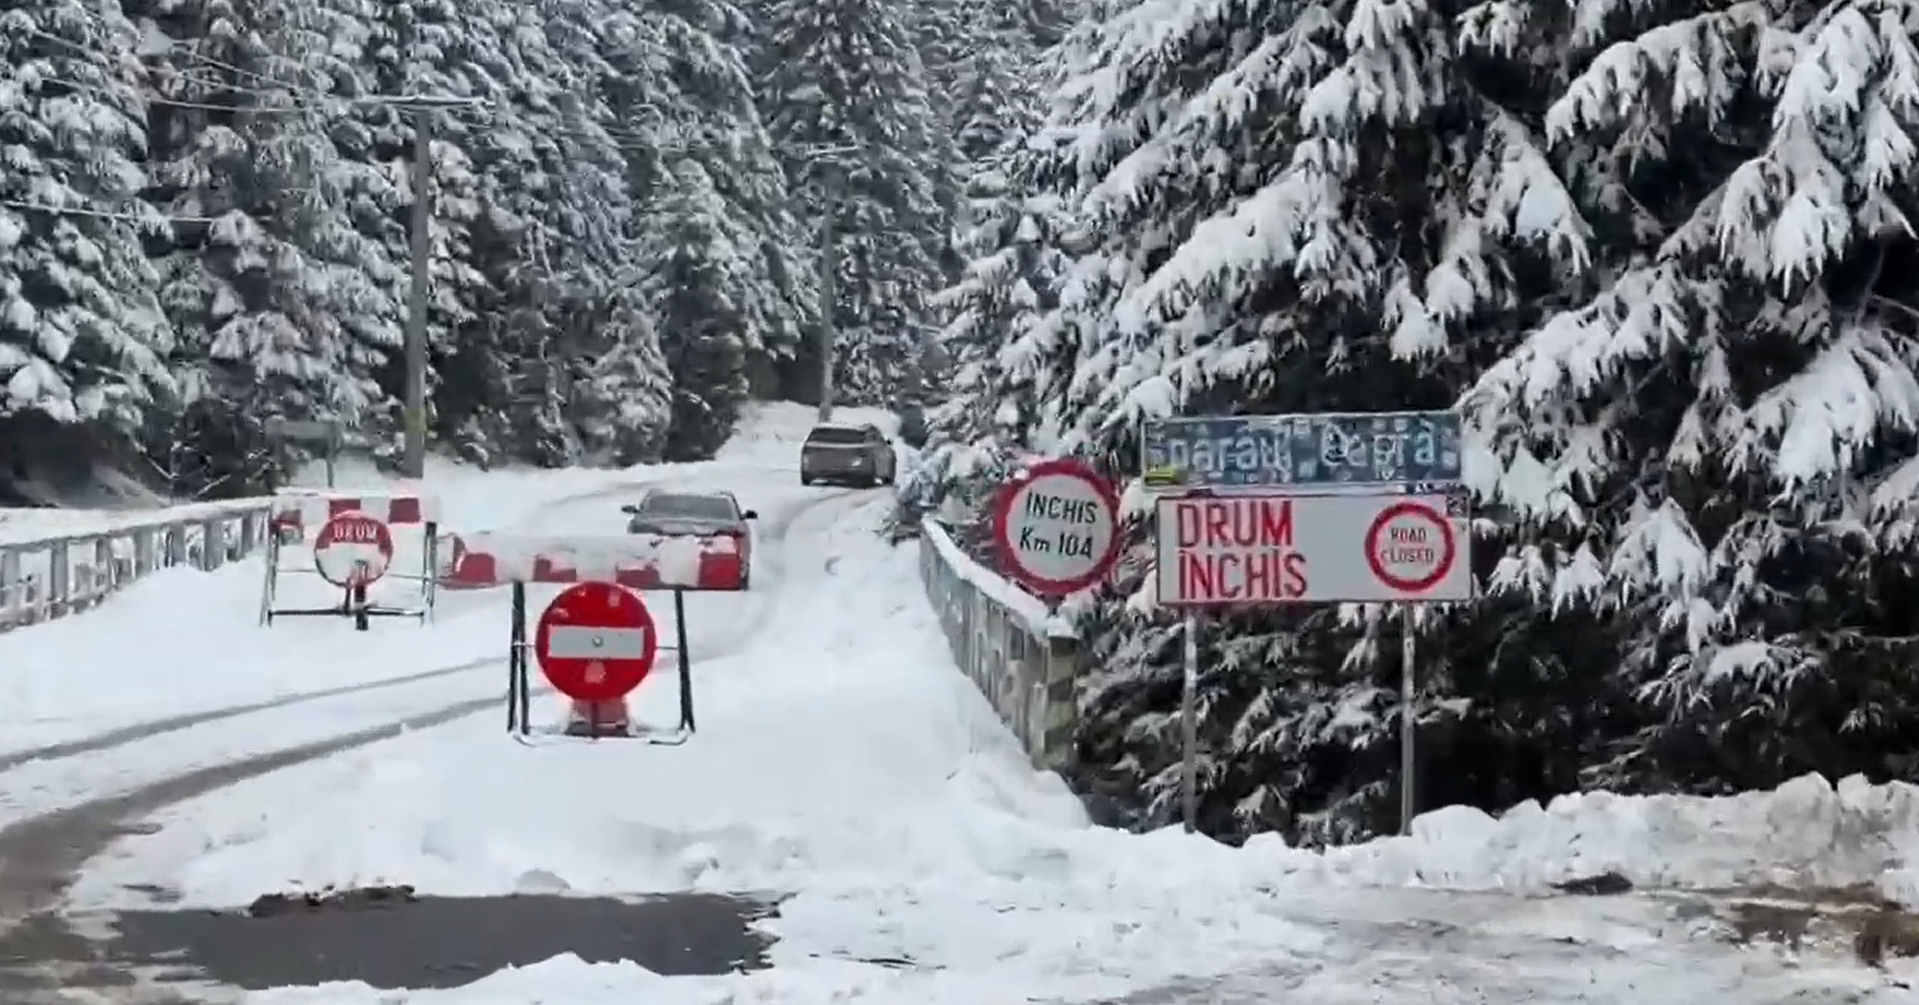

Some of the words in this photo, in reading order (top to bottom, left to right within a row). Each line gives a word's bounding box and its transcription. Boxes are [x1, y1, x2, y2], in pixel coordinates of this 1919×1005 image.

[1026, 488, 1098, 524] INCHIS
[333, 522, 377, 539] DRUM
[1177, 502, 1293, 547] DRUM
[1391, 527, 1427, 542] ROAD
[1020, 526, 1050, 552] Km
[1058, 531, 1094, 559] 104
[1381, 544, 1434, 563] CLOSED
